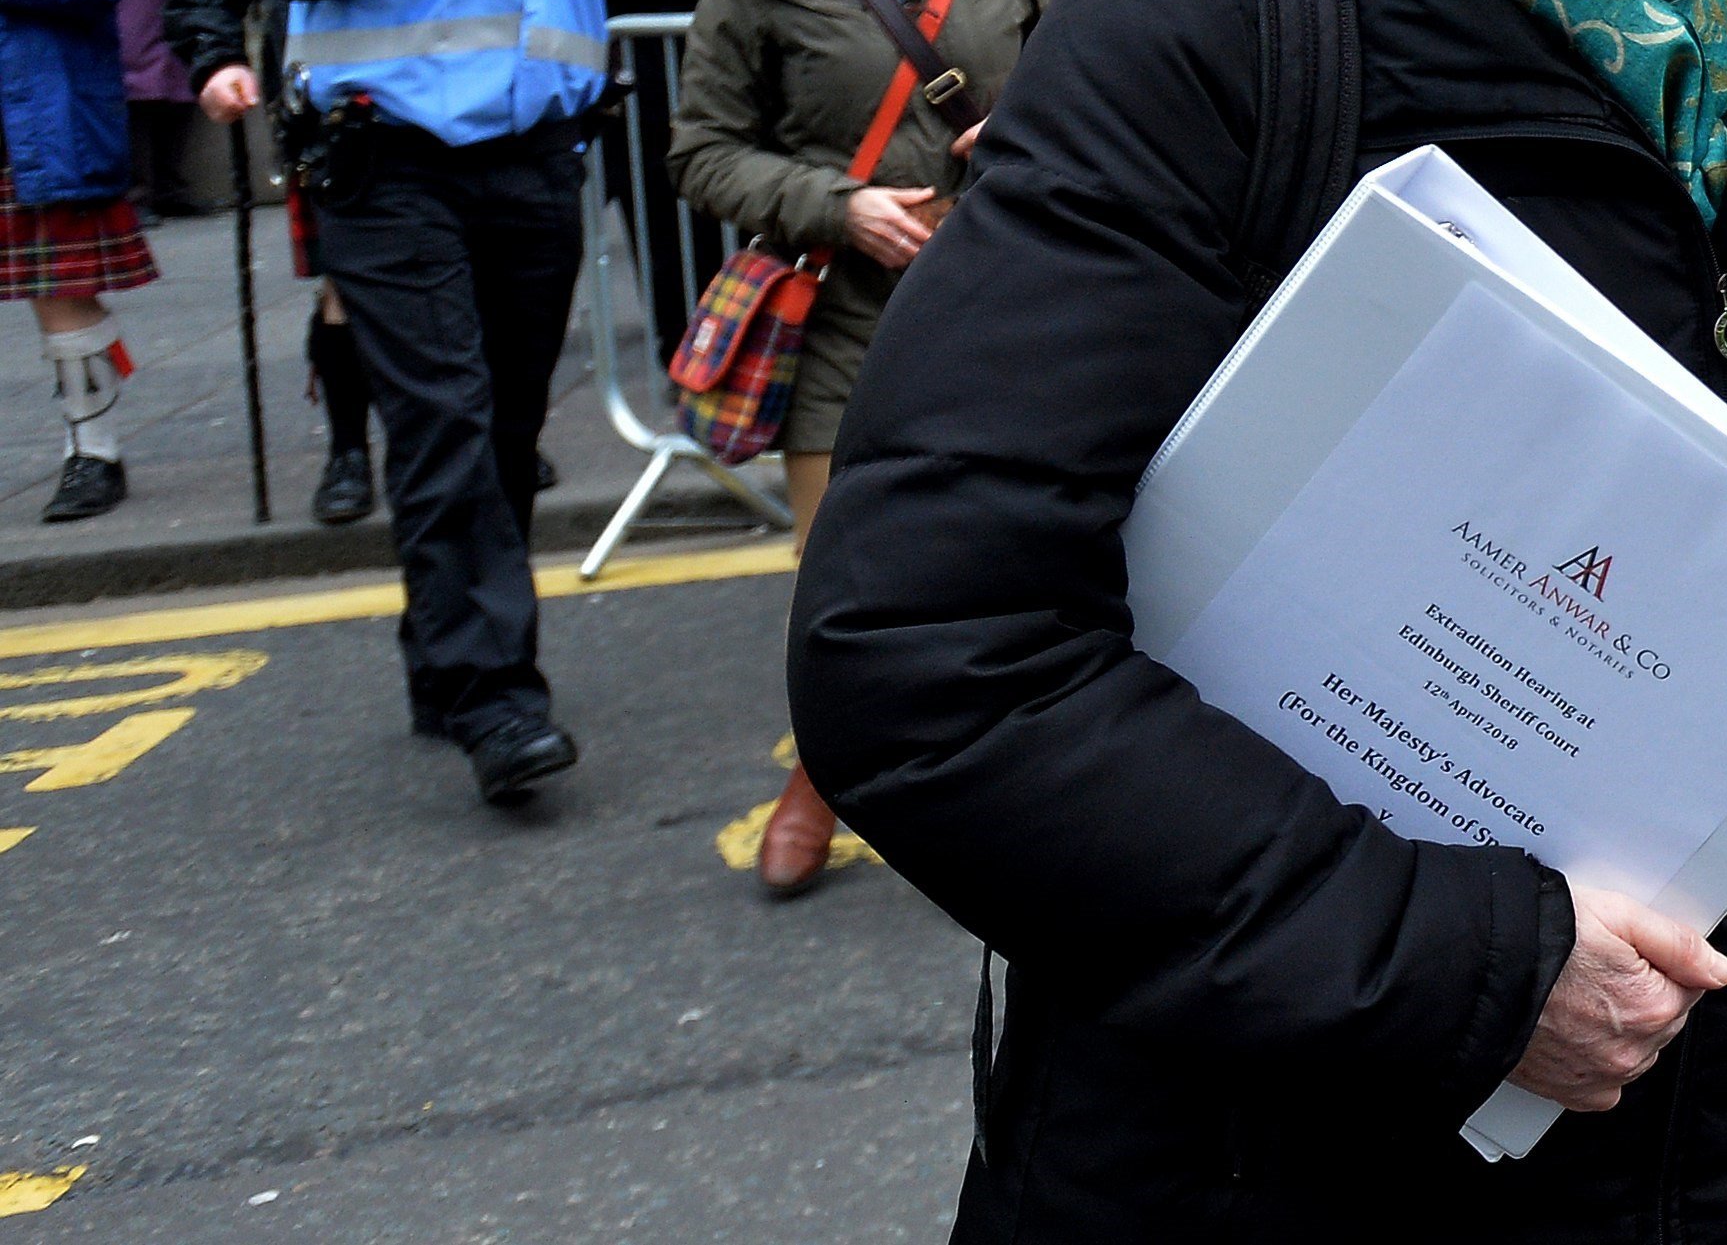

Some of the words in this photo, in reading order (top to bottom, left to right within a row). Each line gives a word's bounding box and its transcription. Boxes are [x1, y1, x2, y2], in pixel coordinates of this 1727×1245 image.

[1452, 521, 1528, 581] AAMER
[1528, 573, 1611, 640] ANWAR
[1612, 633, 1633, 656] &
[1460, 552, 1546, 617] SOLICITORS
[1549, 615, 1560, 628] &
[1564, 625, 1635, 680] NOTARIES
[1398, 624, 1482, 690] Edinburgh
[1480, 682, 1539, 727] Sheriff
[1535, 721, 1581, 759] Court
[1422, 679, 1451, 701] 12th
[1447, 698, 1485, 728] April
[1482, 721, 1520, 751] 2018
[1424, 603, 1514, 673] Extradition
[1513, 666, 1578, 720] Hearing
[1576, 712, 1596, 730] at
[1278, 690, 1327, 728] (For
[1325, 722, 1360, 754] the
[1360, 746, 1449, 818] Kingdom
[1451, 812, 1481, 834] of
[1321, 672, 1364, 707] Her
[1362, 701, 1456, 773] Majesty's
[1453, 768, 1546, 837] Advocate
